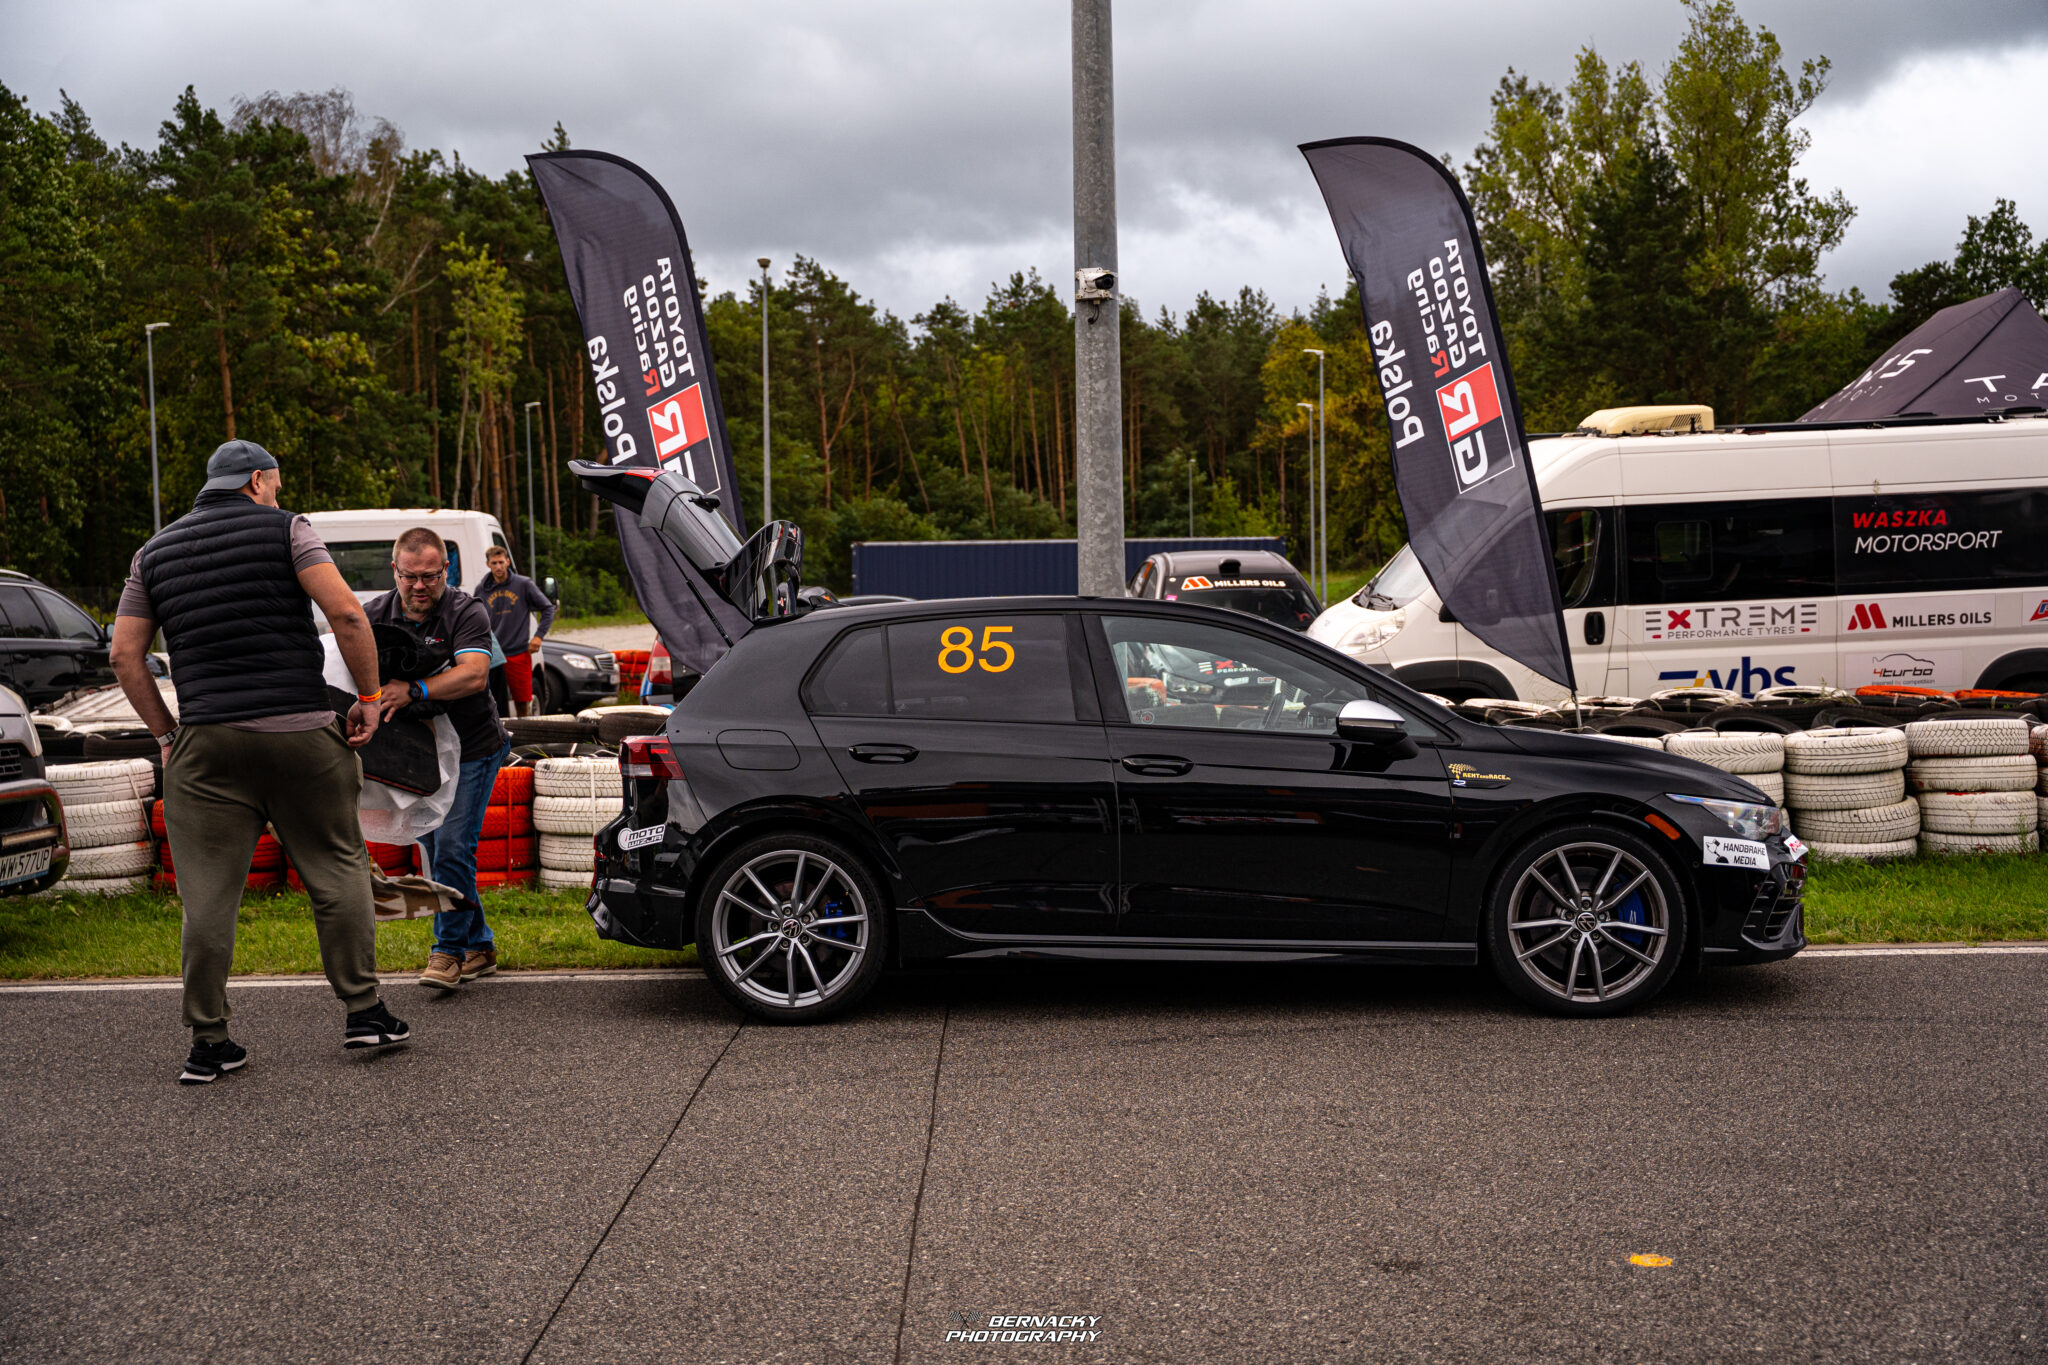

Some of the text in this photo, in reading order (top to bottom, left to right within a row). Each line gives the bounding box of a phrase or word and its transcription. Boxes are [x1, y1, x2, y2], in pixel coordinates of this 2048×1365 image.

[1853, 509, 1948, 528] WASZKA
[1854, 530, 2003, 554] MOTORSPORT
[1214, 580, 1260, 588] MILLERS
[1645, 604, 1817, 631] EXTREME
[1892, 611, 1992, 628] MILLERS OILS
[1667, 625, 1796, 640] PERFORMANCE TYRES
[938, 626, 1015, 673] 85
[1873, 666, 1934, 677] 4turbo
[629, 826, 664, 841] MOTO
[1723, 842, 1766, 856] HANDBRAKE
[17, 849, 50, 876] 577UP
[1733, 856, 1757, 866] MEDIA
